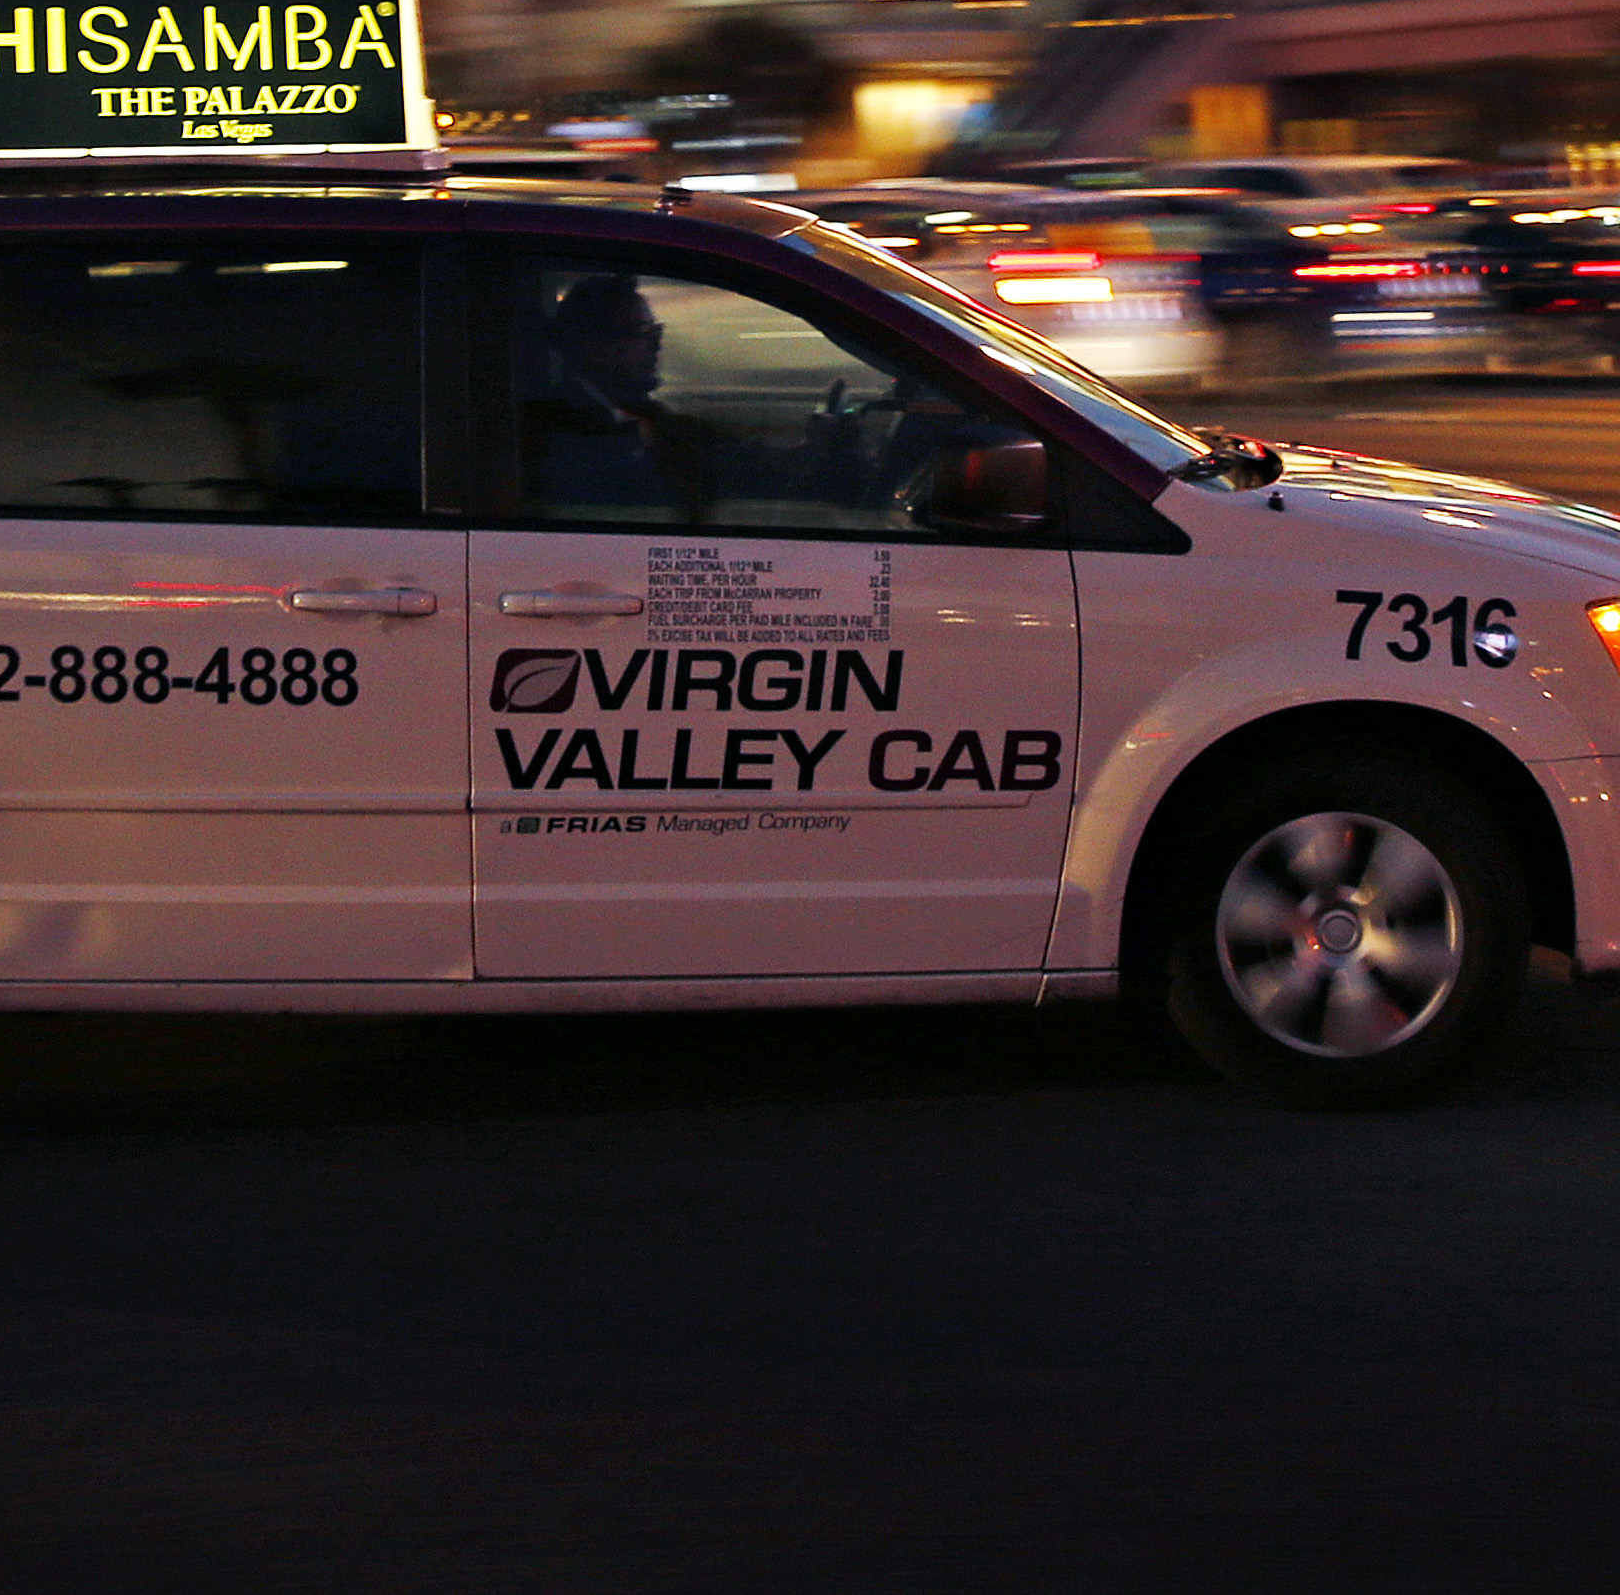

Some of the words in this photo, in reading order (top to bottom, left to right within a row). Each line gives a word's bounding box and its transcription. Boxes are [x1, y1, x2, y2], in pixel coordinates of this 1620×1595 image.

[91, 87, 177, 117] THE
[182, 83, 359, 116] PALAZZO
[182, 120, 218, 139] Las
[218, 119, 273, 143] Vegas
[648, 547, 673, 559] FIRST
[698, 548, 720, 559] MILE
[648, 560, 672, 572] EACH
[675, 560, 726, 573] ADDITIONAL
[752, 561, 773, 573] MILE
[648, 573, 684, 586] WAITING
[711, 574, 729, 586] PER
[731, 574, 757, 586] HOUR
[648, 587, 672, 600] EACH
[674, 587, 694, 600] TRIP
[695, 588, 721, 600] FROM
[723, 588, 772, 600] McCARRAN
[774, 588, 822, 601] PROPERTY
[709, 601, 735, 613] CARD
[737, 601, 753, 613] FEE
[648, 614, 670, 626] FUEL
[672, 614, 727, 626] SURCHARGE
[729, 614, 747, 626] PER
[749, 614, 769, 626] PAID
[771, 614, 791, 627] MILE
[793, 614, 837, 627] INCLUDED
[839, 615, 848, 627] IN
[850, 615, 873, 628] FARE
[662, 629, 694, 642] EXCISE
[695, 629, 712, 642] TAX
[713, 629, 734, 642] WILL
[737, 629, 749, 642] BE
[750, 629, 782, 642] ADDED
[783, 630, 796, 642] TO
[797, 630, 814, 642] ALL
[816, 630, 845, 642] RATES
[846, 630, 865, 642] AND
[866, 630, 891, 642] FEES
[1336, 589, 1518, 668] 7316
[583, 648, 905, 712] VIRGIN
[494, 728, 847, 791] VALLEY
[867, 729, 1062, 792] CAB
[546, 816, 647, 834] FRIAS
[656, 815, 750, 835] Managed
[758, 813, 851, 832] Company
